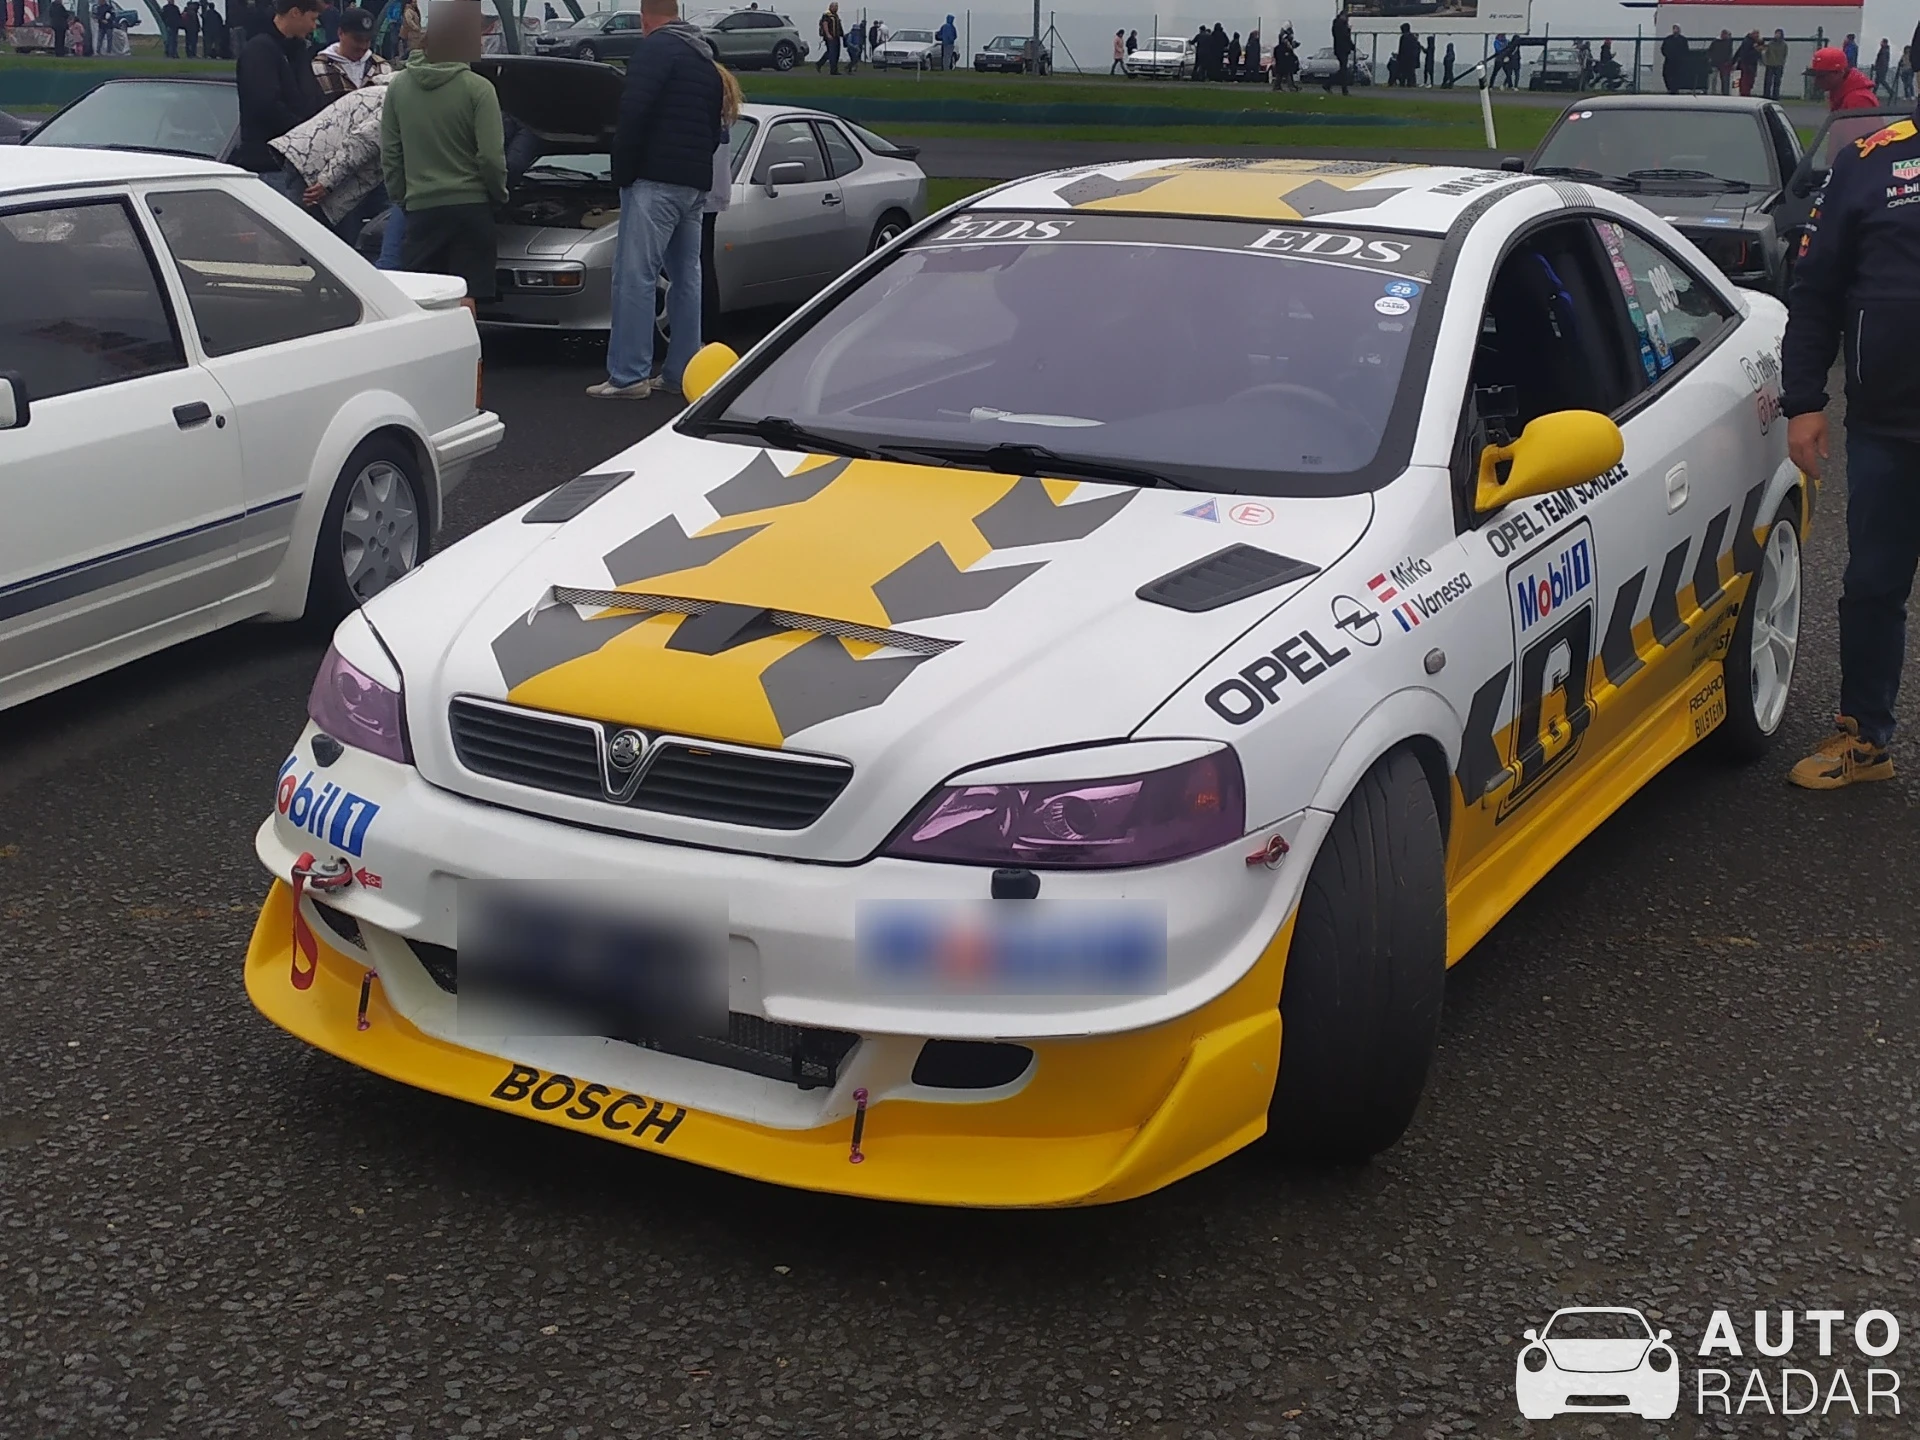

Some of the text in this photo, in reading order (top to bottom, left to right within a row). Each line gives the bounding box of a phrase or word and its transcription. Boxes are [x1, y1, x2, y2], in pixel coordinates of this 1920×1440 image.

[1886, 182, 1920, 198] Mobil
[1887, 195, 1920, 209] ORAC
[931, 219, 1076, 241] EDS
[1244, 228, 1412, 263] EDS
[1390, 285, 1412, 295] 28
[1486, 510, 1546, 558] OPEL
[1532, 488, 1579, 527] TEAM
[1389, 555, 1433, 591] Mirko
[1517, 550, 1574, 632] Mobil
[1410, 571, 1473, 619] Vanessa
[1204, 629, 1352, 726] OPEL
[1689, 674, 1724, 714] RECARO
[1694, 697, 1725, 739] BILSTEIN
[490, 1063, 687, 1145] BOSCH
